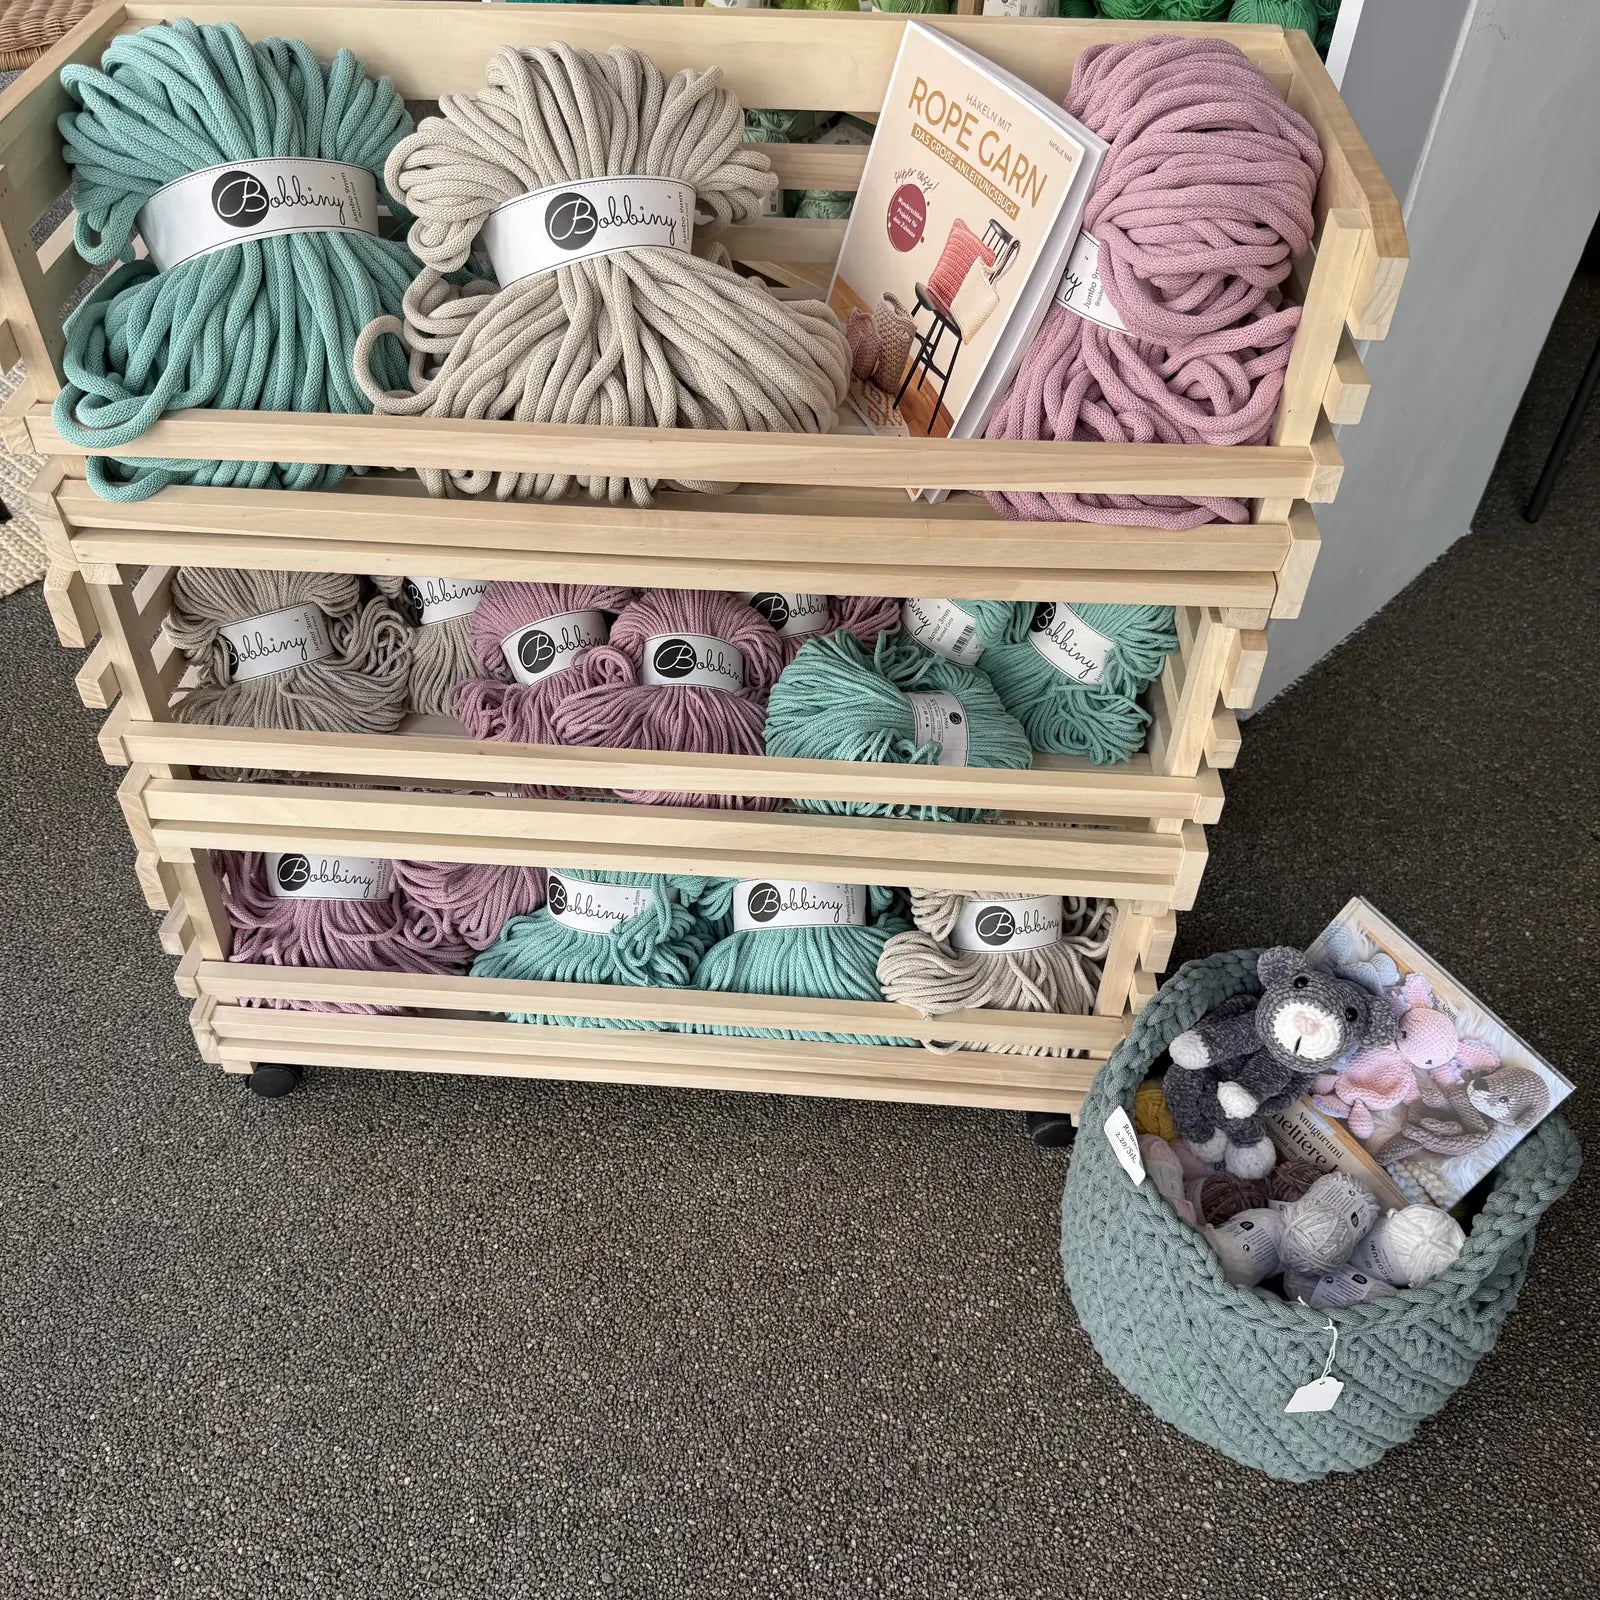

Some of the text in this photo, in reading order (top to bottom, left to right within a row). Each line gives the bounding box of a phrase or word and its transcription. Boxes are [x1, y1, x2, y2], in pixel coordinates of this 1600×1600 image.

[908, 76, 1048, 208] ROPE GARN
[997, 115, 1013, 133] MIT
[914, 127, 931, 145] DAS
[956, 160, 1017, 215] ANLEITUNGSBUCH
[216, 175, 345, 226] Bobbiny
[348, 195, 360, 223] Jumbo
[549, 194, 677, 246] Bobbiny
[1083, 281, 1097, 309] Jumbo
[928, 608, 951, 642] Junior 3mm
[655, 644, 742, 683] Bobbin
[279, 857, 374, 898] Bobbiny
[749, 887, 843, 923] Bobbiny
[1115, 1131, 1137, 1164] 2.20/Stk.
[1296, 1111, 1345, 1160] Amigurumi
